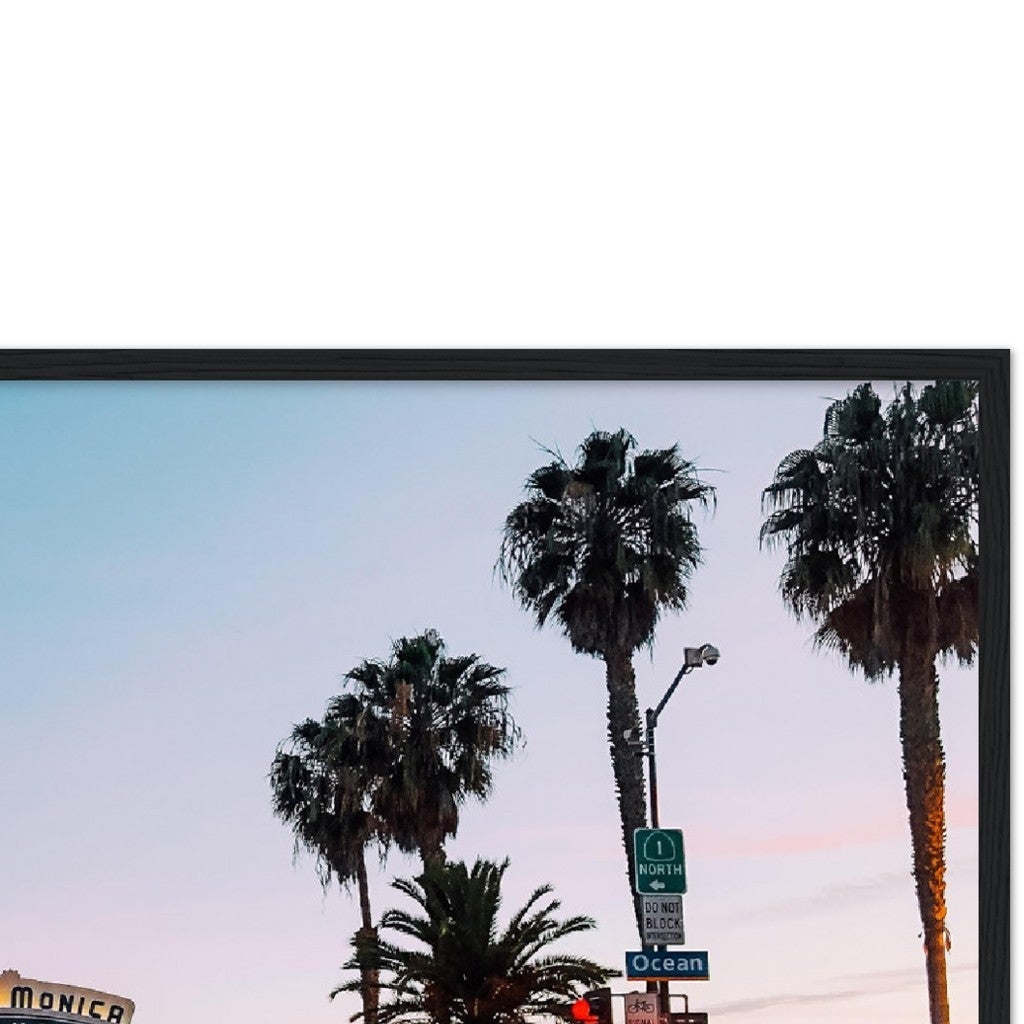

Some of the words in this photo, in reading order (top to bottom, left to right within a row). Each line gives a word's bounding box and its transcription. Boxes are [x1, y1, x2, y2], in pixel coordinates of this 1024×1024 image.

[657, 840, 663, 855] 1
[639, 863, 683, 875] NORTH
[645, 901, 658, 913] DO
[661, 902, 680, 913] NOT
[646, 917, 682, 929] BLOCK
[632, 954, 704, 972] Ocean
[11, 986, 125, 1024] MONICA
